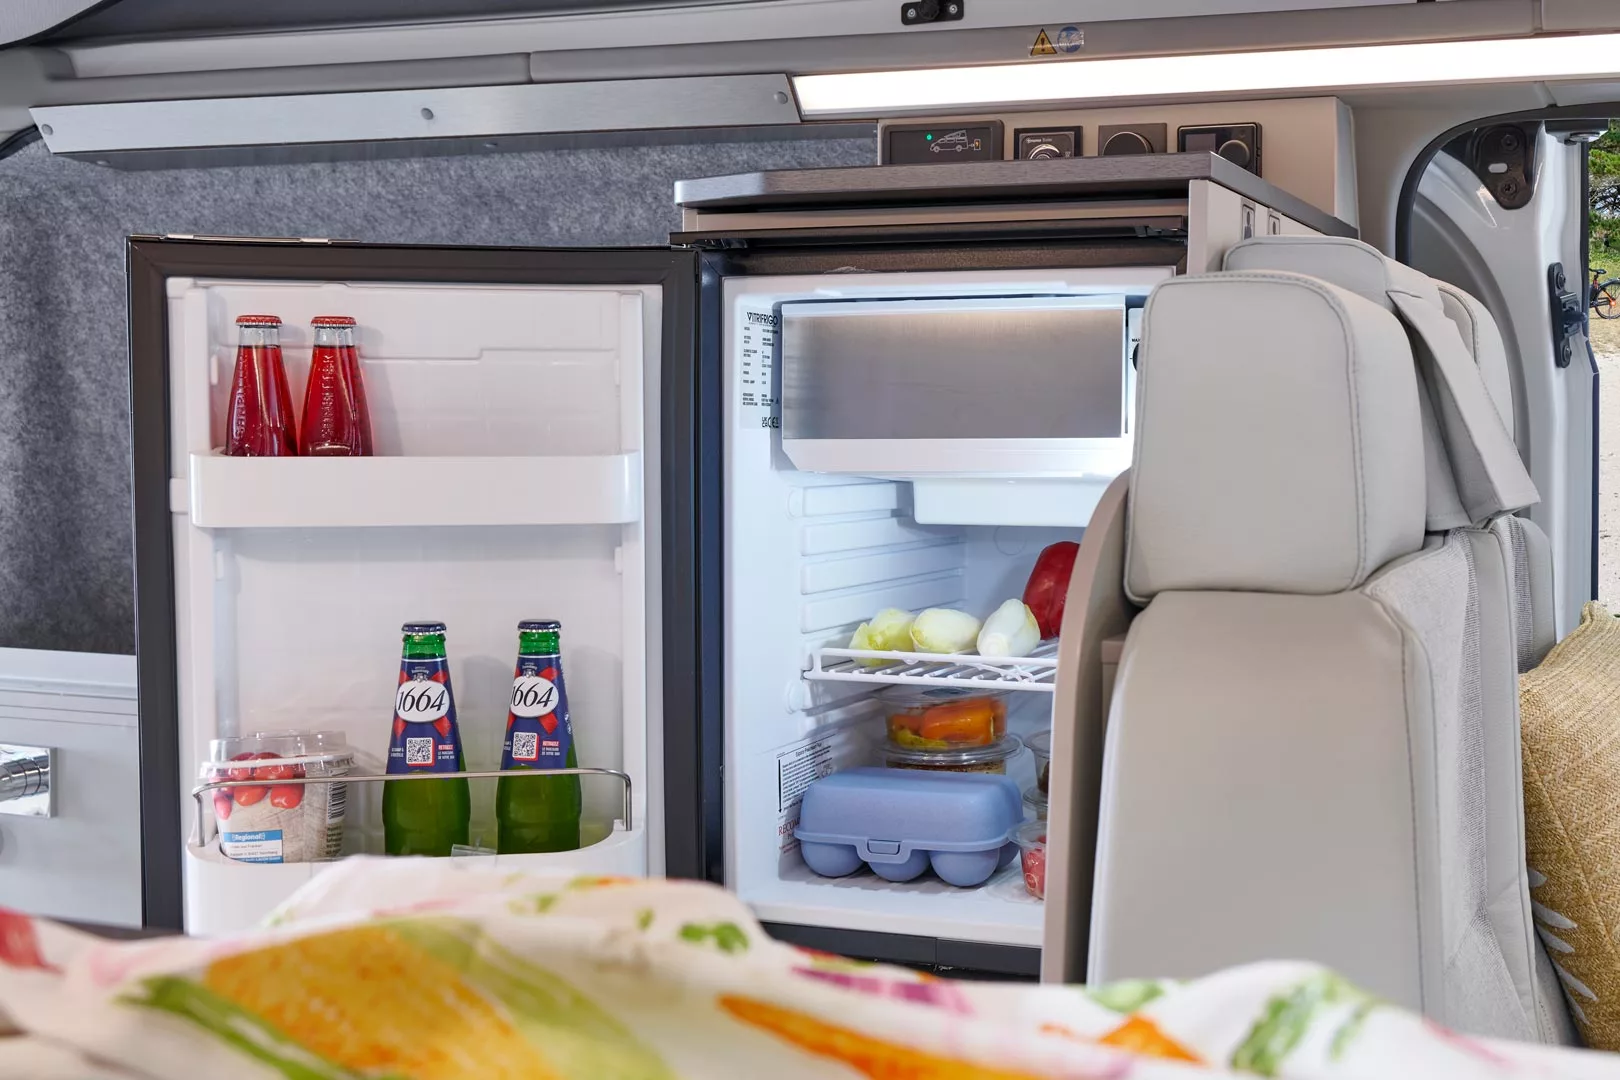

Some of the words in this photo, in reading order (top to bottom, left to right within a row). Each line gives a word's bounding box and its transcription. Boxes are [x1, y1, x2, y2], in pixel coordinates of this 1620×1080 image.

[746, 311, 778, 325] VITRIFRIGO
[398, 686, 446, 712] 1664
[510, 681, 554, 708] 1664
